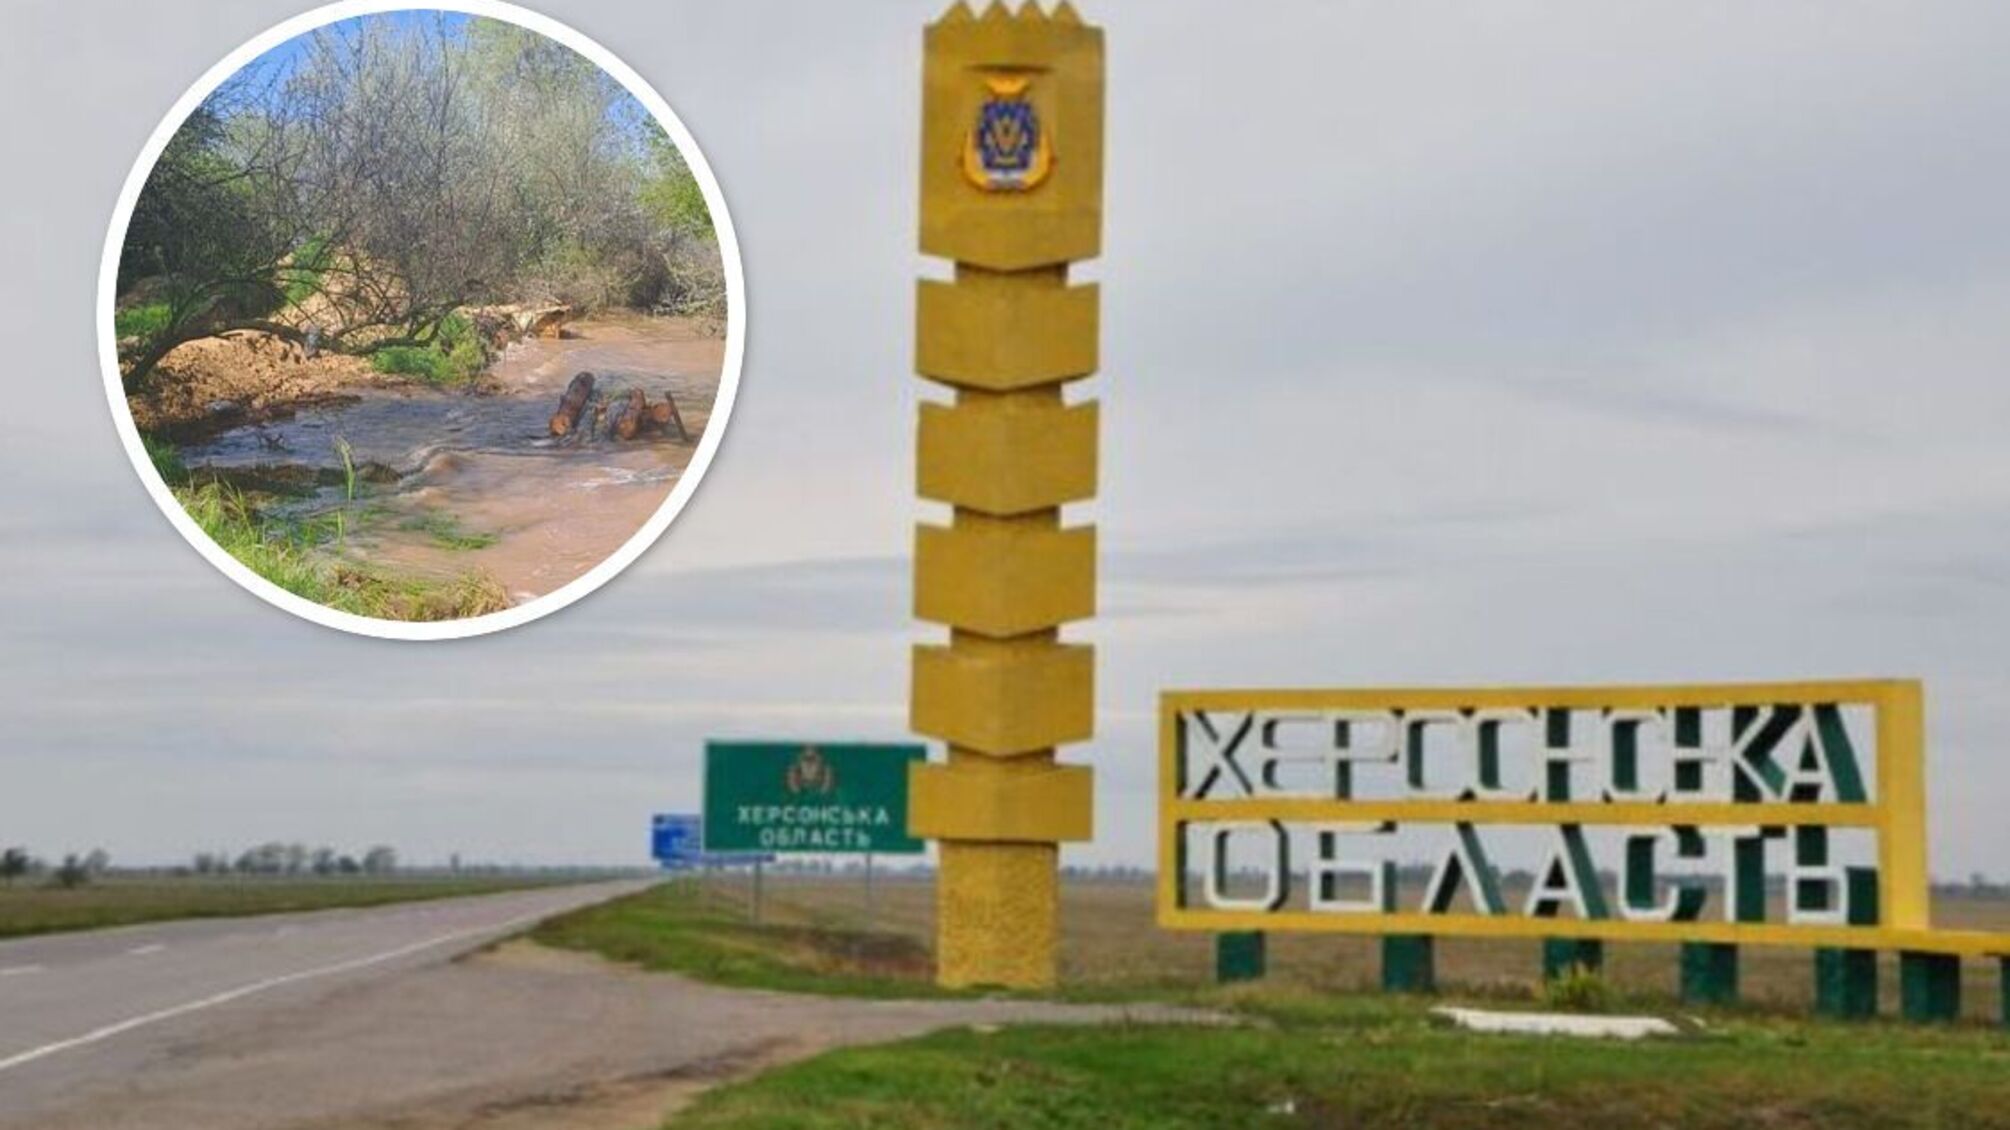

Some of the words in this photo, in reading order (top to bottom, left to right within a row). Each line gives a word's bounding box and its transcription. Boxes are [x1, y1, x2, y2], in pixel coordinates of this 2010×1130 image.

[737, 805, 890, 825] ХЕРСОНСЬКА
[759, 827, 871, 847] ОБЛАСТЬ
[1203, 820, 1850, 925] ОБЛАСТЬ
